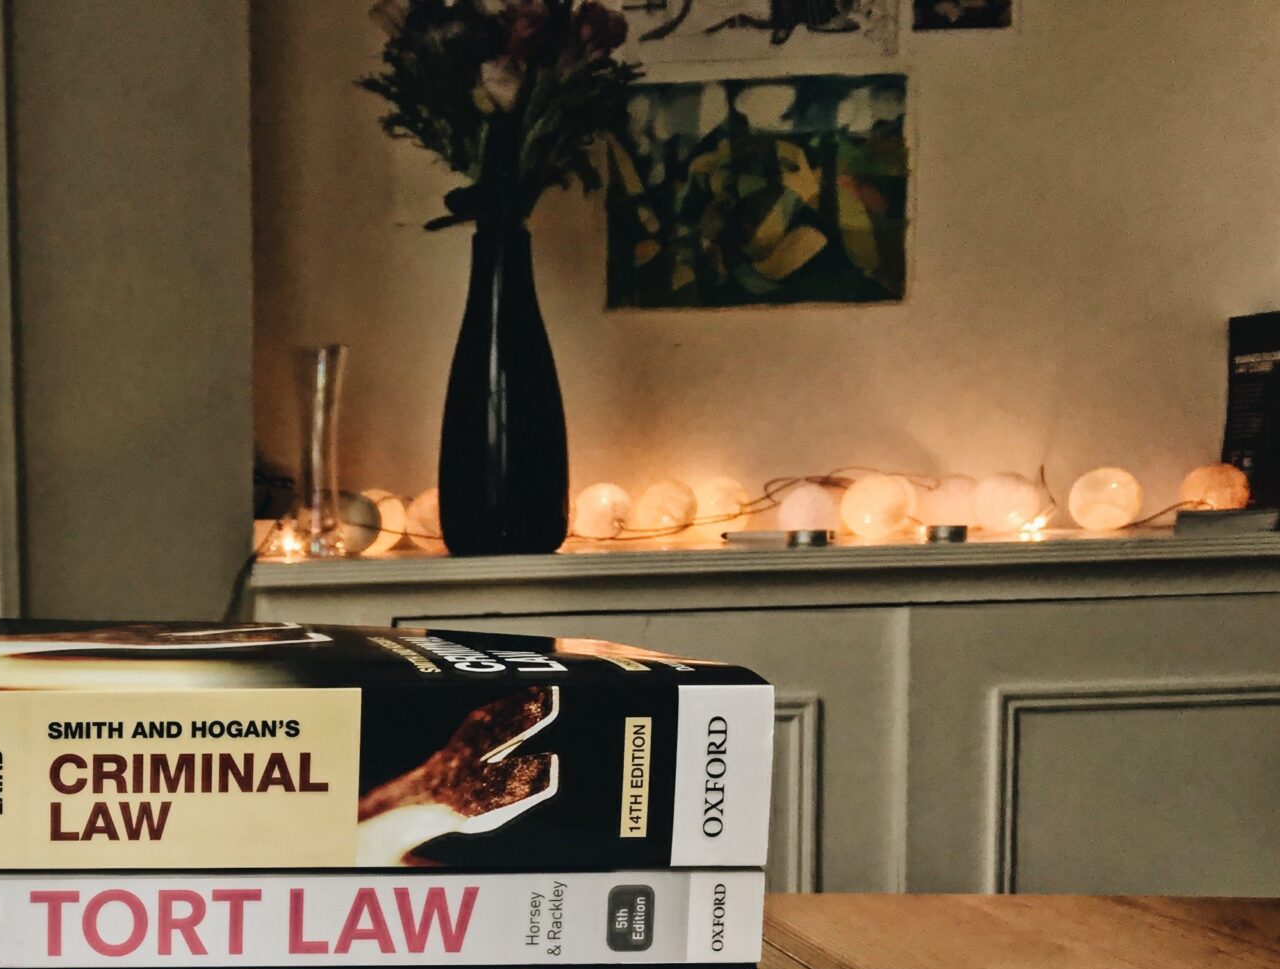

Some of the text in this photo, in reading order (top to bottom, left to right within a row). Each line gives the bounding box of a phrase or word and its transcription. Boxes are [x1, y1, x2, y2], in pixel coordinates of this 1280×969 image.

[486, 650, 568, 672] LAW
[47, 719, 301, 740] SMITH AND HOGAN'S
[49, 752, 329, 795] CRIMINAL
[629, 724, 646, 833] 14TH EDITION
[702, 715, 728, 838] OXFORD
[50, 801, 171, 841] LAW
[29, 886, 480, 957] TORT LAW
[525, 891, 545, 946] Horsey
[547, 880, 568, 956] & Rackley
[616, 908, 628, 929] 5th
[632, 896, 646, 940] Edition
[711, 883, 727, 952] OXFORD
